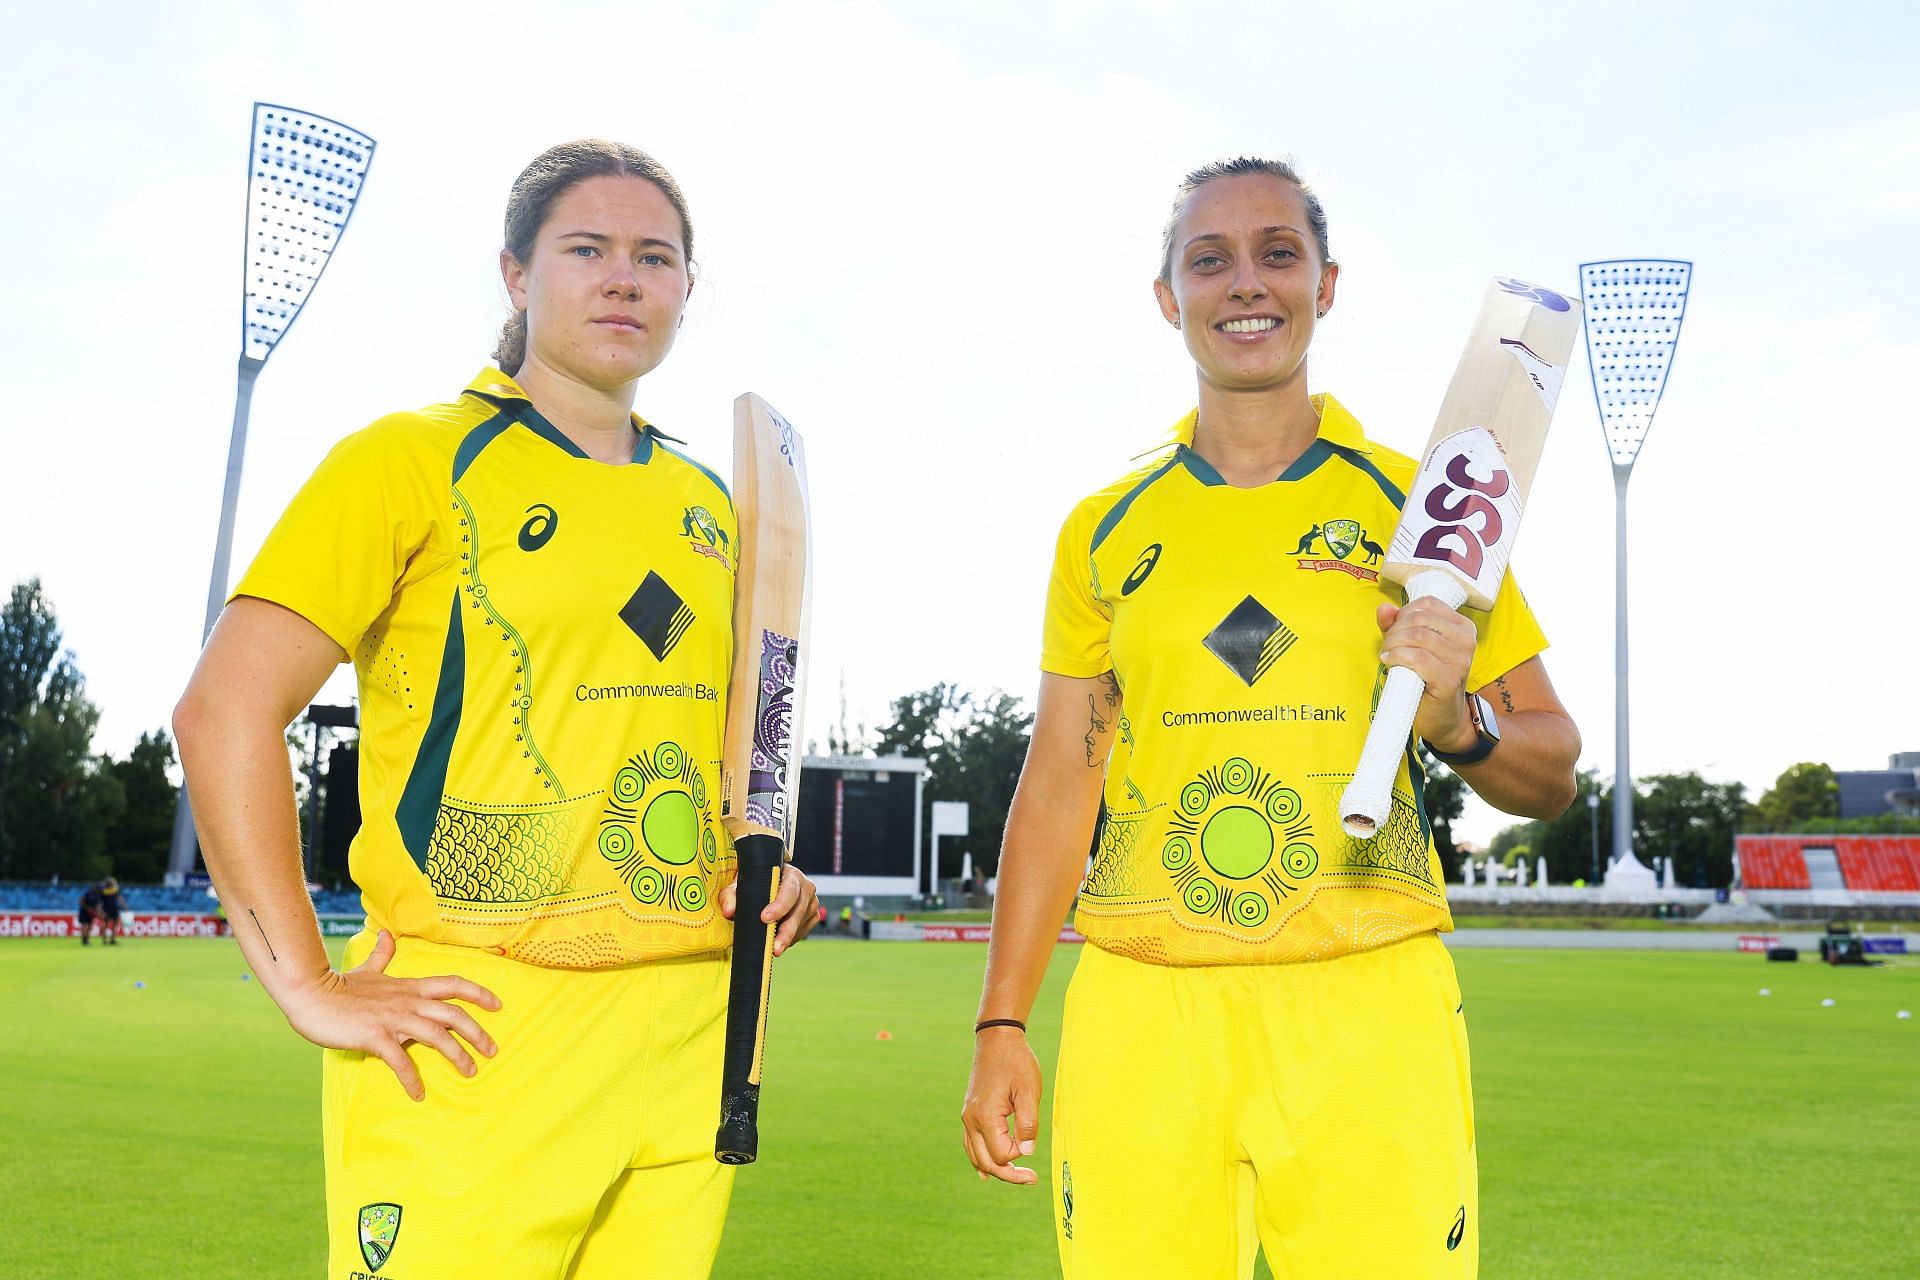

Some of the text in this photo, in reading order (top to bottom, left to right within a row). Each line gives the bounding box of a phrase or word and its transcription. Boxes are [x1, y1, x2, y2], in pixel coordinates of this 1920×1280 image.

[1529, 372, 1545, 391] FLIP
[1413, 453, 1510, 581] DSC
[1319, 561, 1361, 577] AUSTRALIA
[575, 682, 719, 702] Commonwealth Bak
[1162, 704, 1347, 727] Commonwealth Bank
